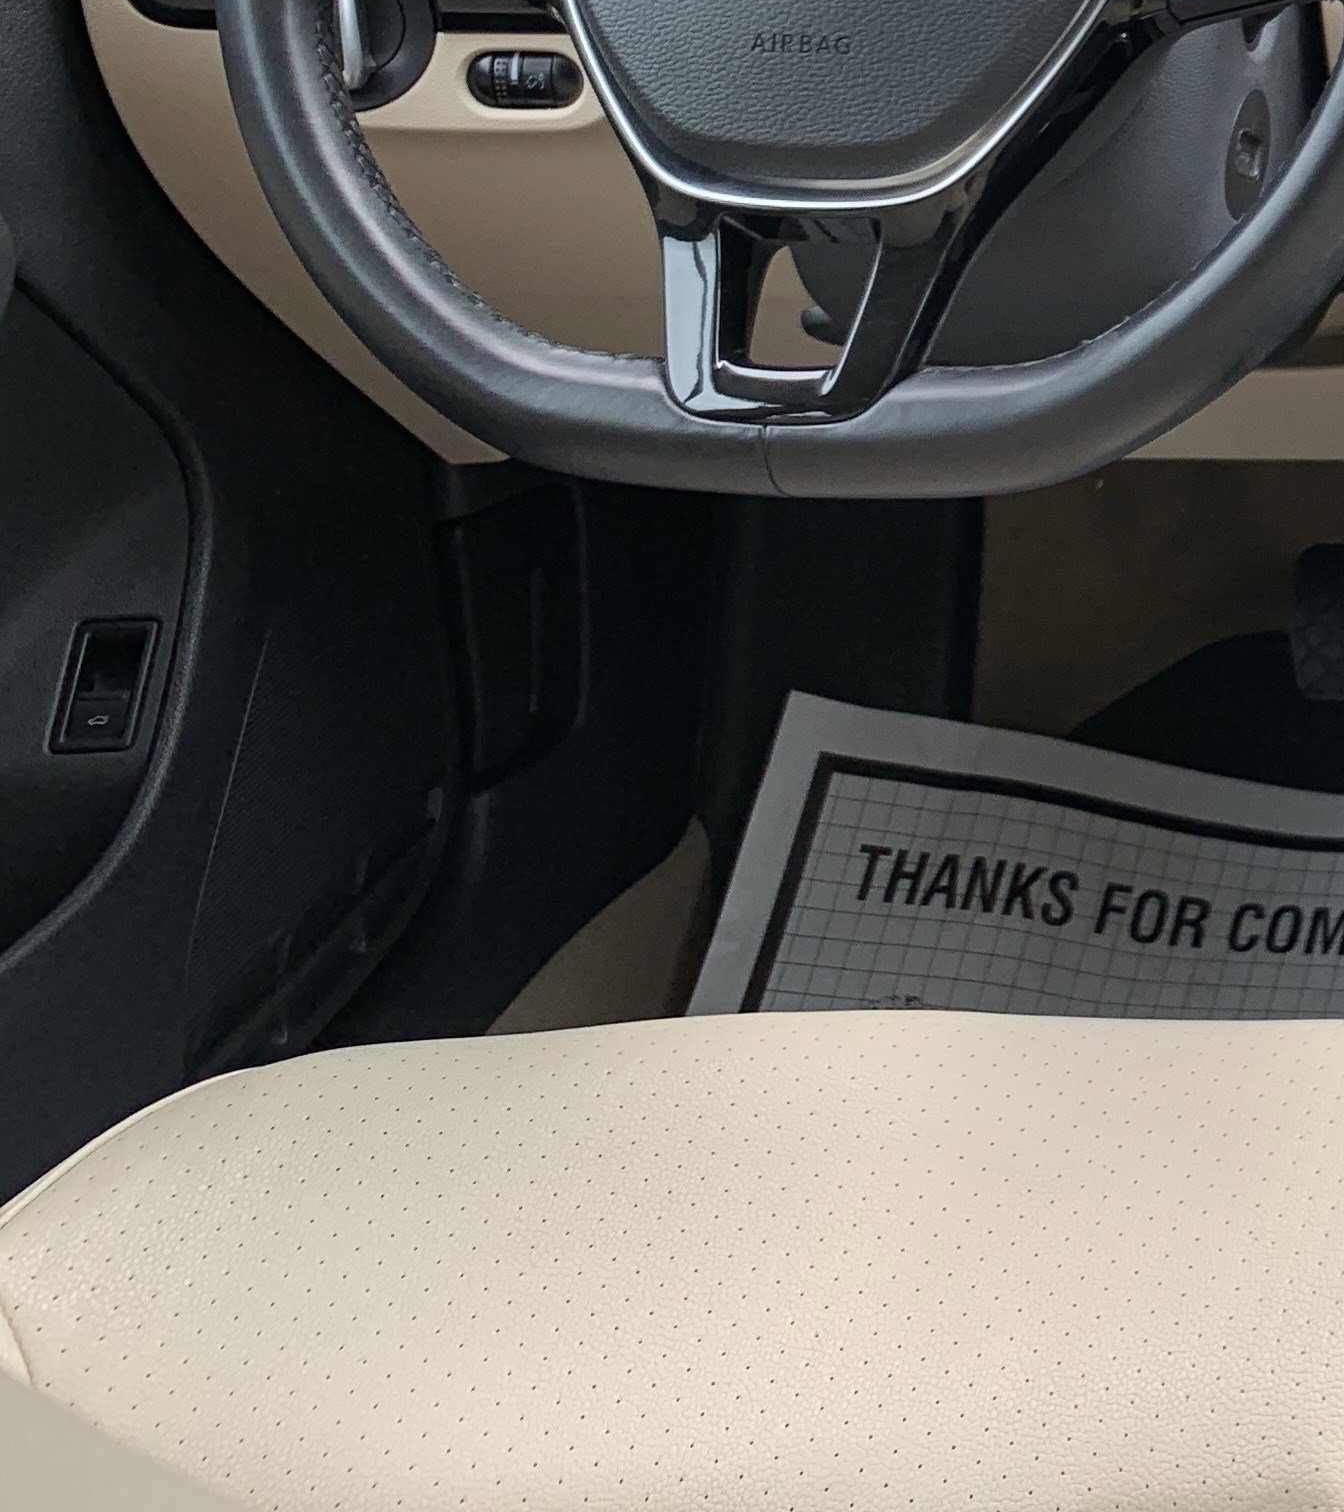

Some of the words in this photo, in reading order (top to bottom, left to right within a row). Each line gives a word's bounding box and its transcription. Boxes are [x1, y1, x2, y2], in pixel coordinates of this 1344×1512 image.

[751, 33, 851, 55] AIRBAG
[855, 843, 1080, 927] THANKS
[1093, 881, 1212, 948] FOR
